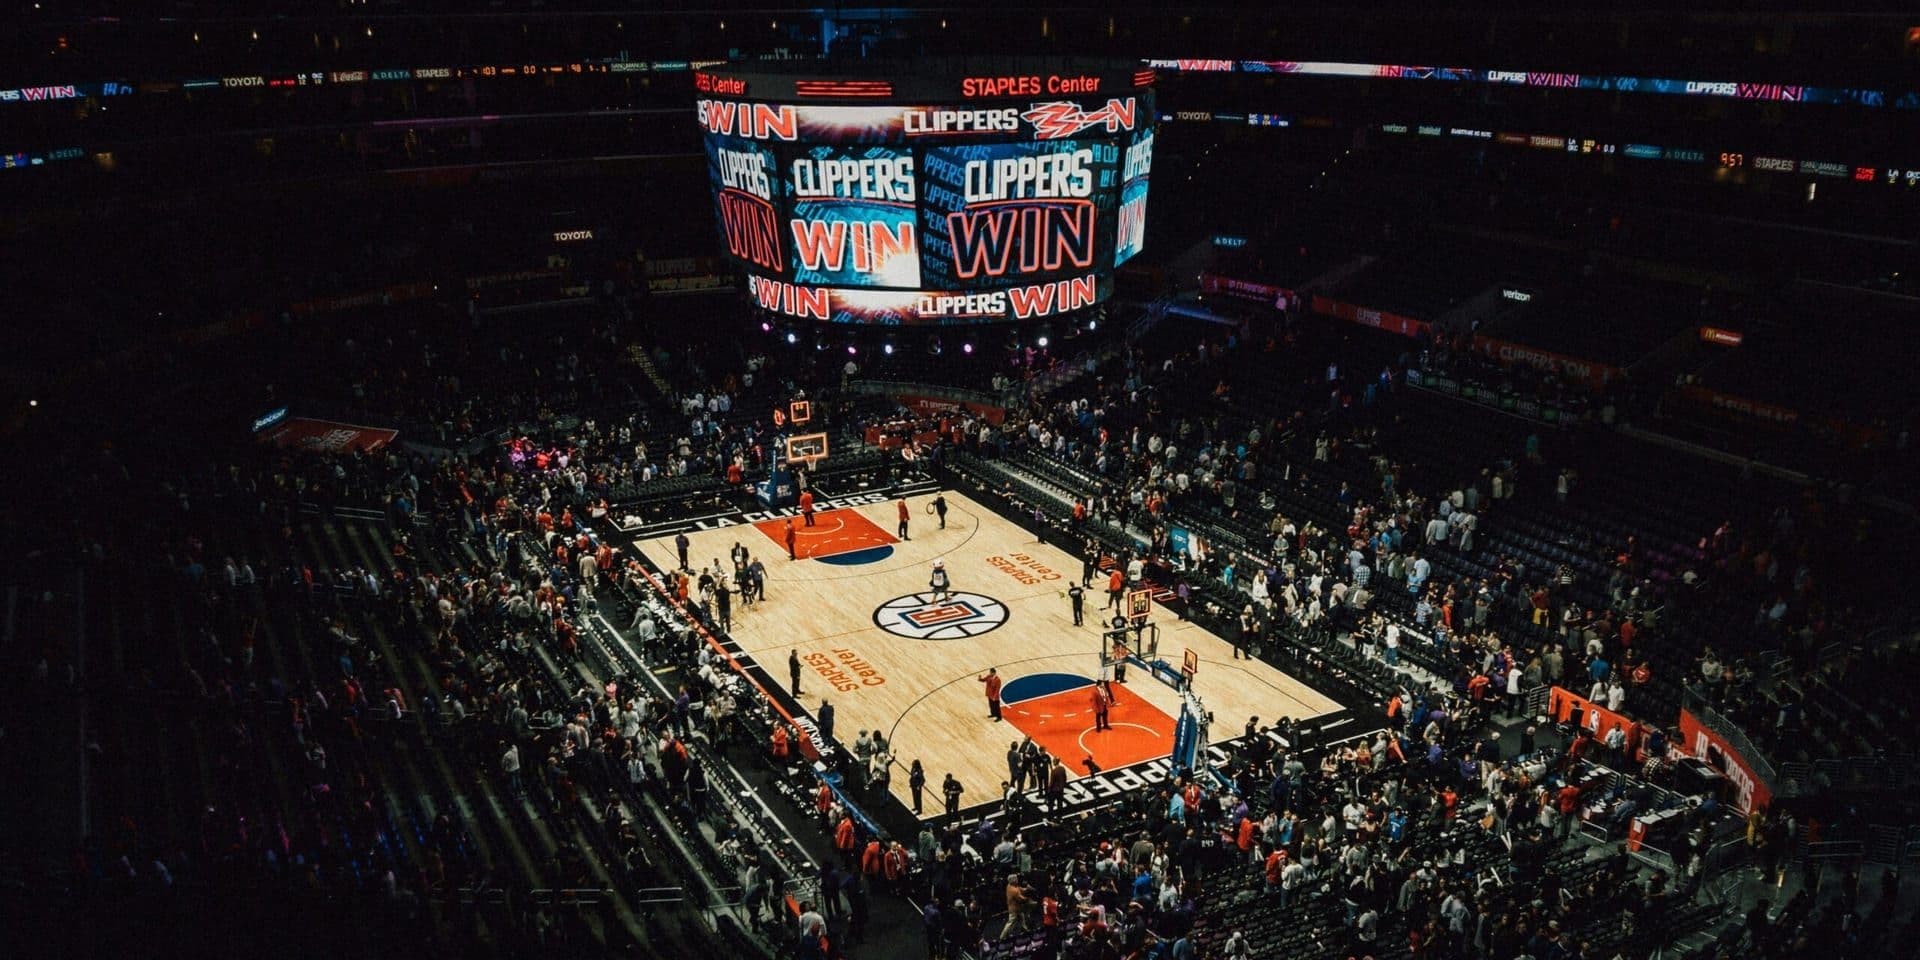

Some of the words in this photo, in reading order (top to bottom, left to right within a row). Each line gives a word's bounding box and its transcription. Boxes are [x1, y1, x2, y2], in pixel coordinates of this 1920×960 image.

[223, 77, 264, 87] TOYOTA
[380, 71, 410, 80] DELTA
[415, 69, 450, 80] STAPLES
[1488, 70, 1526, 81] CLIPPERS
[1526, 71, 1579, 88] WIN
[21, 85, 76, 101] WIN
[712, 77, 746, 95] Center
[963, 76, 1041, 97] STAPLES
[1047, 75, 1100, 94] Center
[1686, 81, 1737, 95] CLIPPERS
[1737, 83, 1803, 102] WIN
[706, 99, 798, 141] WIN
[903, 108, 1019, 133] CLIPPERS
[1177, 112, 1211, 121] TOYOTA
[1674, 150, 1704, 160] DELTA
[1755, 157, 1795, 170] STAPLES
[718, 147, 771, 201] CLIPPERS
[793, 156, 916, 202] CLIPPERS
[964, 149, 1093, 203] CLIPPERS
[1888, 168, 1899, 177] LA
[553, 230, 593, 241] TOYOTA
[719, 192, 783, 273] WIN
[947, 204, 1095, 279] WIN
[1222, 237, 1247, 246] DELTA
[790, 218, 915, 273] WIN
[755, 275, 830, 320] WIN
[918, 291, 1006, 315] CLIPPERS
[1009, 274, 1096, 319] WIN
[1502, 288, 1531, 302] verizon
[697, 516, 739, 532] LA
[985, 556, 1041, 585] STAPLES
[1008, 553, 1062, 581] Center
[803, 653, 860, 692] STAPLES
[831, 649, 886, 686] Center
